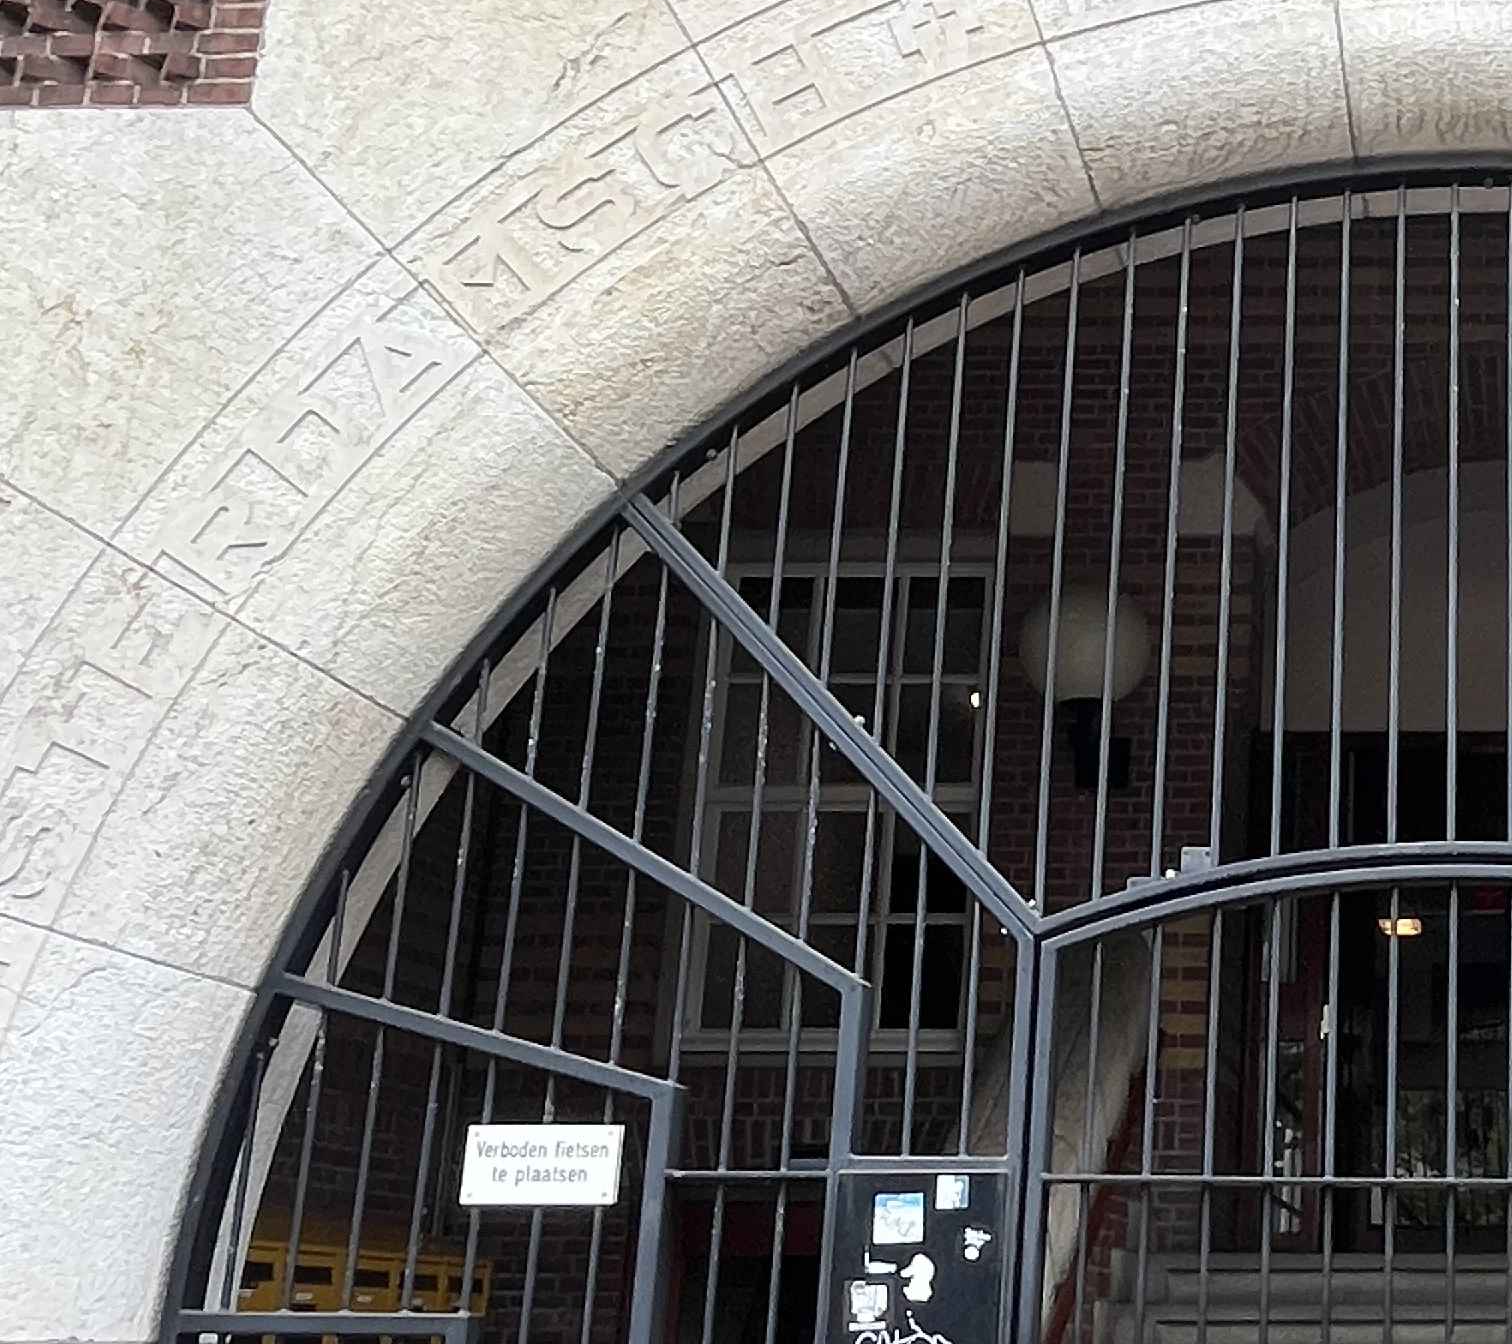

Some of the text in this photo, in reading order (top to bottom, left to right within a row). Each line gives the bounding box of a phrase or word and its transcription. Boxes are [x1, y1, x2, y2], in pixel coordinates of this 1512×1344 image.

[476, 1140, 610, 1158] Verboden fietsen
[492, 1165, 589, 1187] te plaatsen
